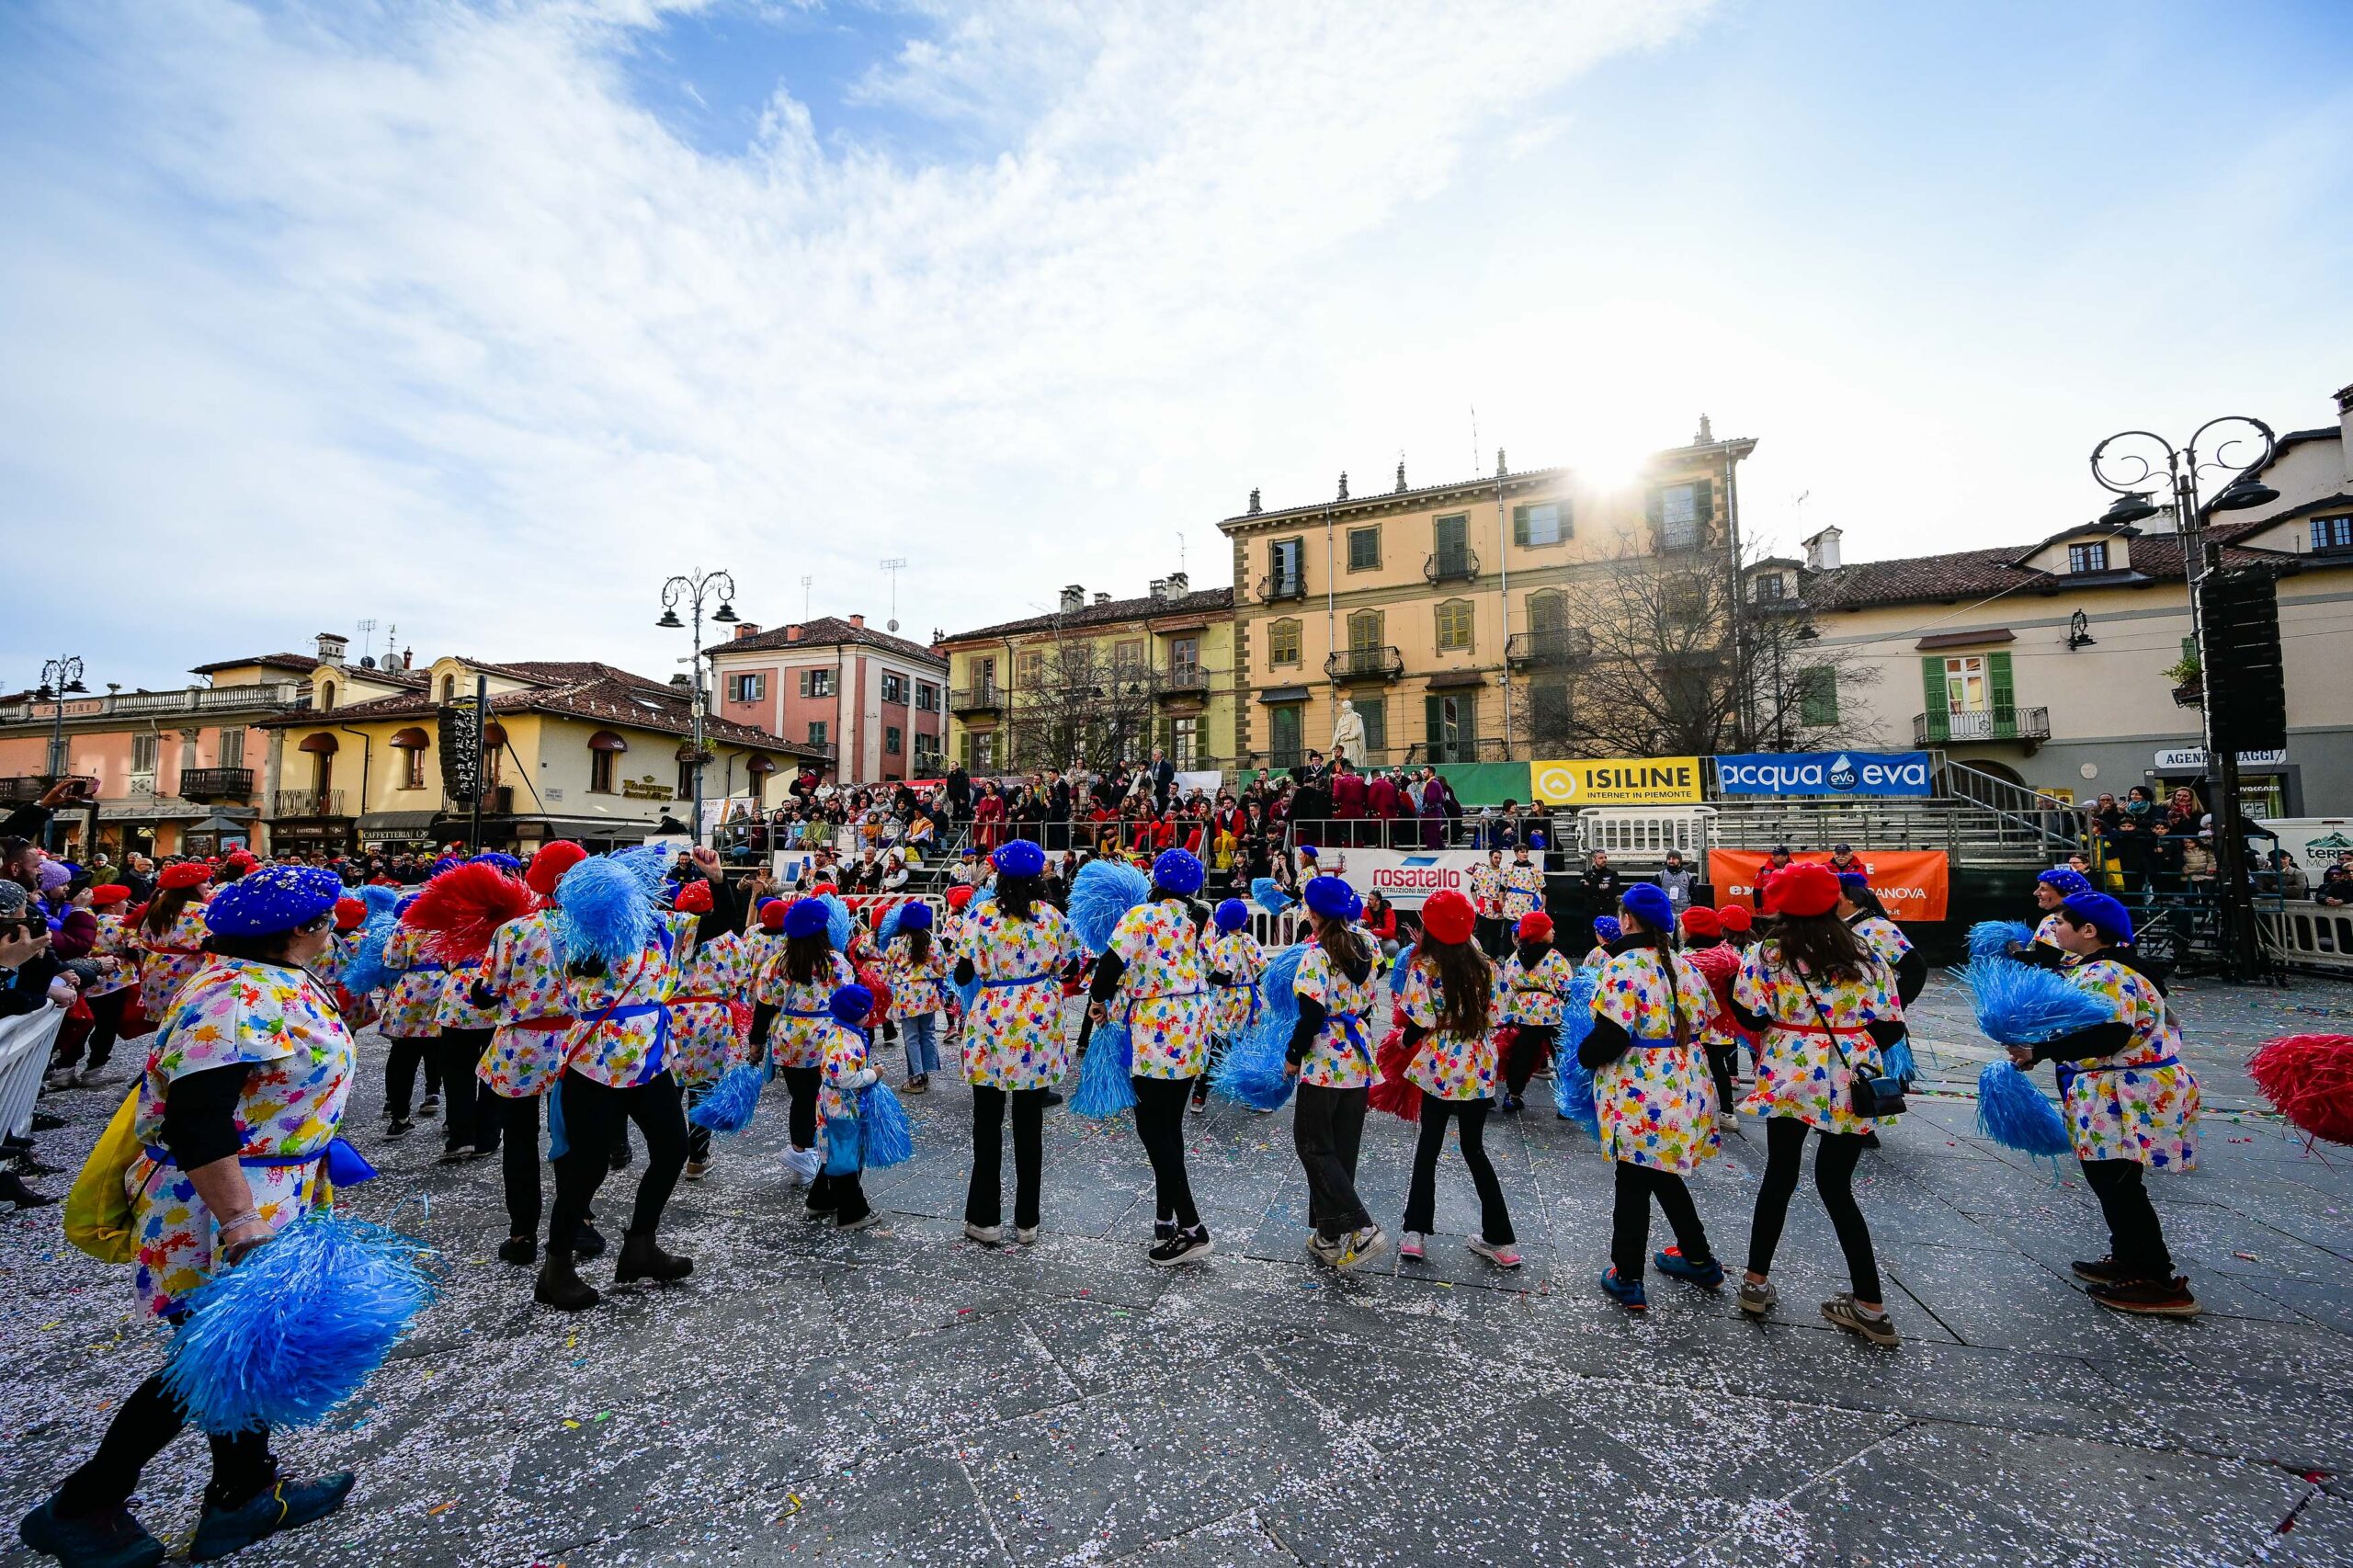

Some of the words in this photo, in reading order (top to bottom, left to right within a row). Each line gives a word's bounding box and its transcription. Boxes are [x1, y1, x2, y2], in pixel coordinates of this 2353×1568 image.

[1586, 767, 1690, 789] ISILINE
[1722, 764, 1823, 791] acqua
[1862, 764, 1925, 785] eva
[1830, 771, 1855, 783] eva
[363, 831, 411, 840] CAFFETTERIA
[1373, 868, 1461, 889] rosatello
